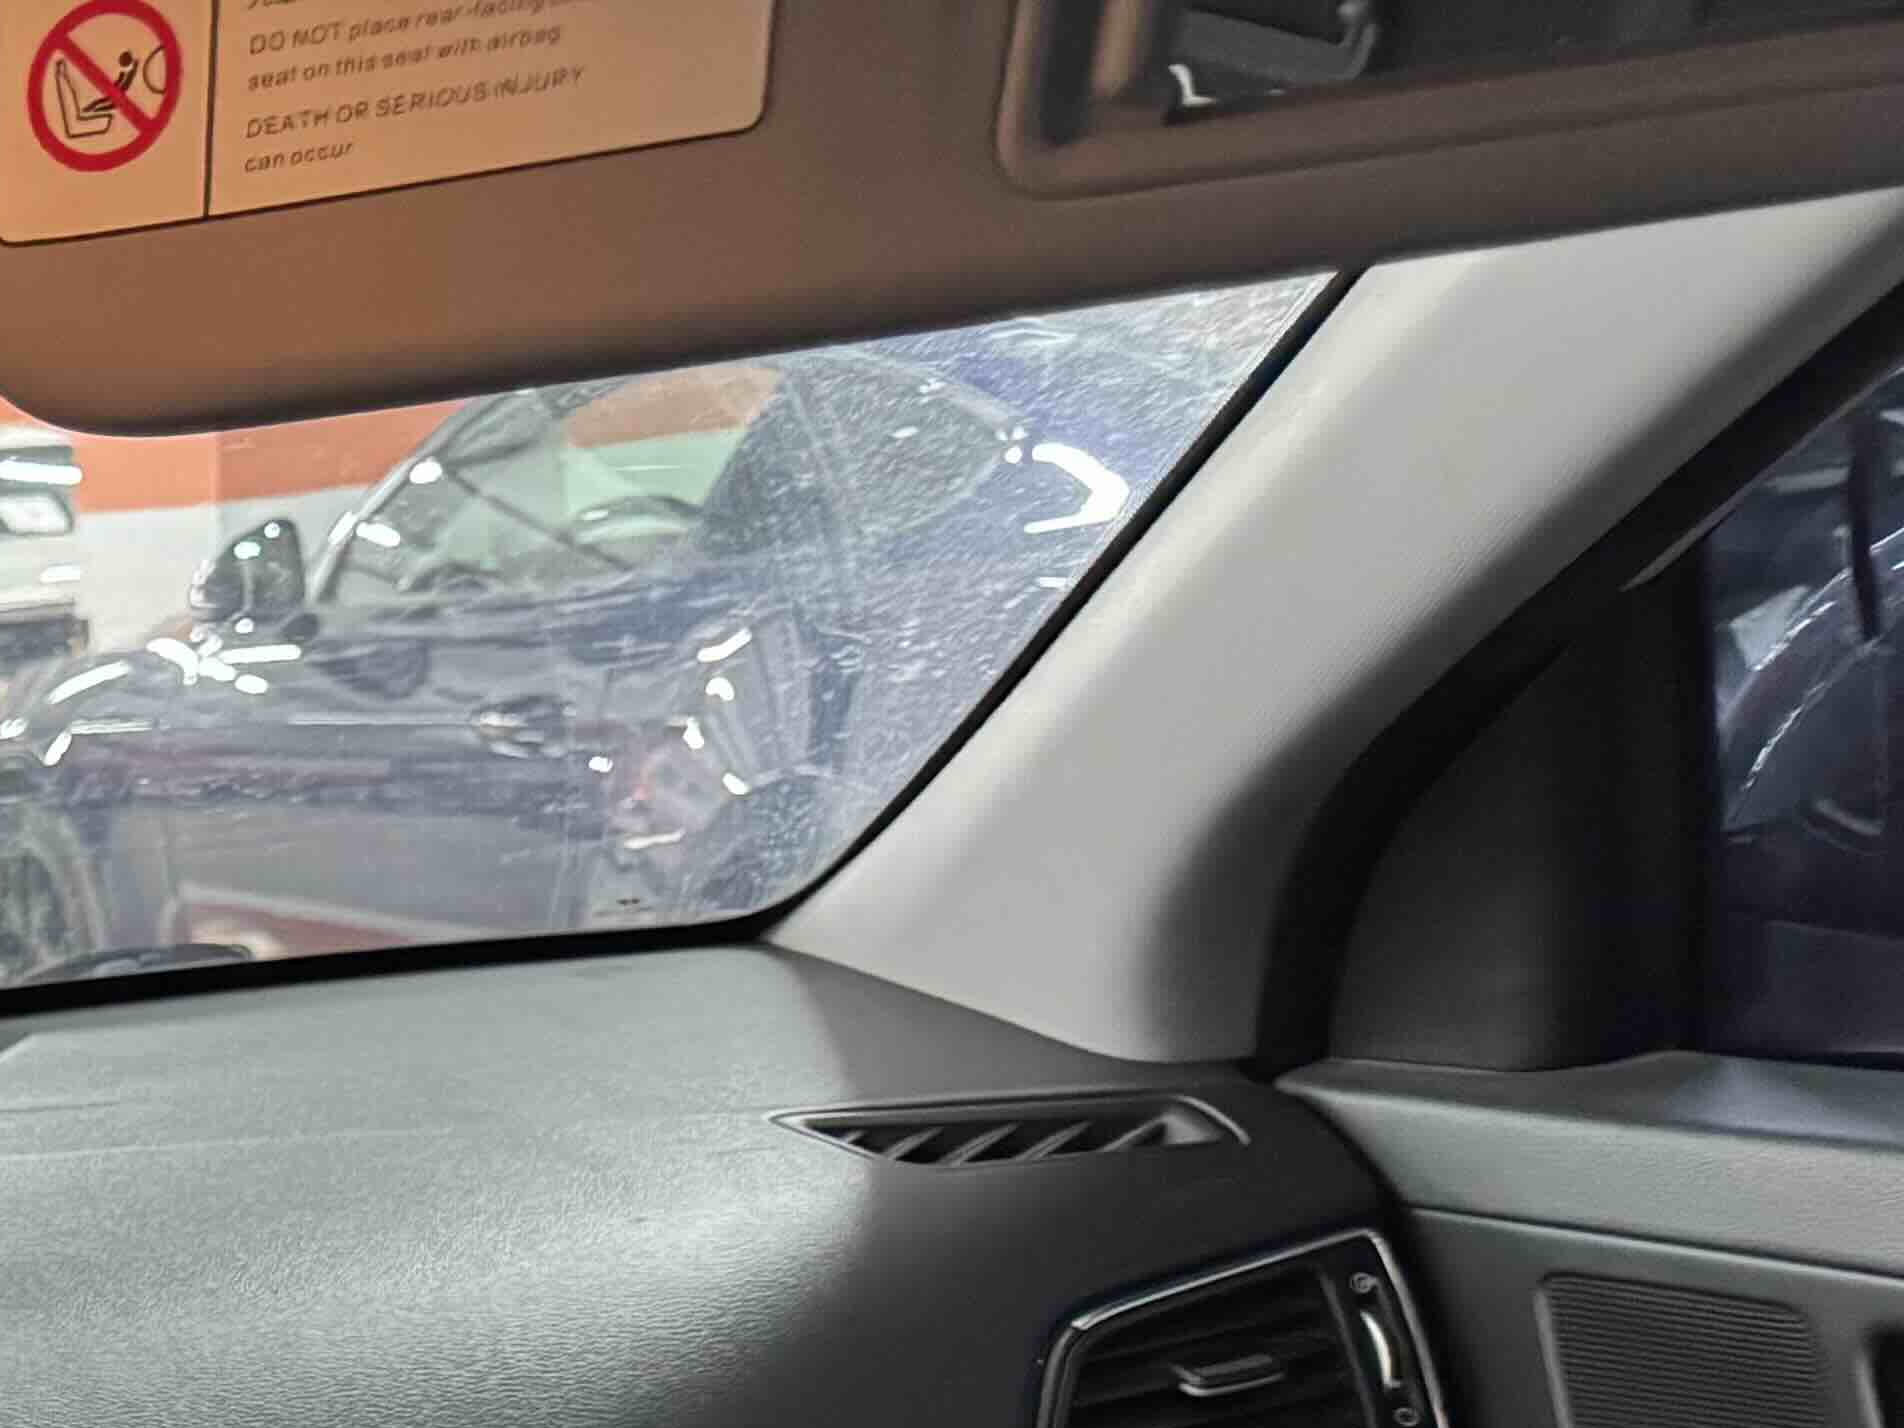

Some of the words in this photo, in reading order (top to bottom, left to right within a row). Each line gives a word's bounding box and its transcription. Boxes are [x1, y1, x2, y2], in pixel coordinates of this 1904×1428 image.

[249, 29, 286, 55] DO
[291, 21, 343, 48] NOT
[246, 66, 298, 92] seat
[302, 62, 330, 82] on
[336, 53, 377, 76] this
[245, 106, 329, 139] DEATH
[335, 101, 370, 124] OR
[375, 81, 490, 119] SERIOUS
[493, 65, 586, 101] INJURY
[244, 151, 285, 174] can
[291, 141, 354, 167] occur
